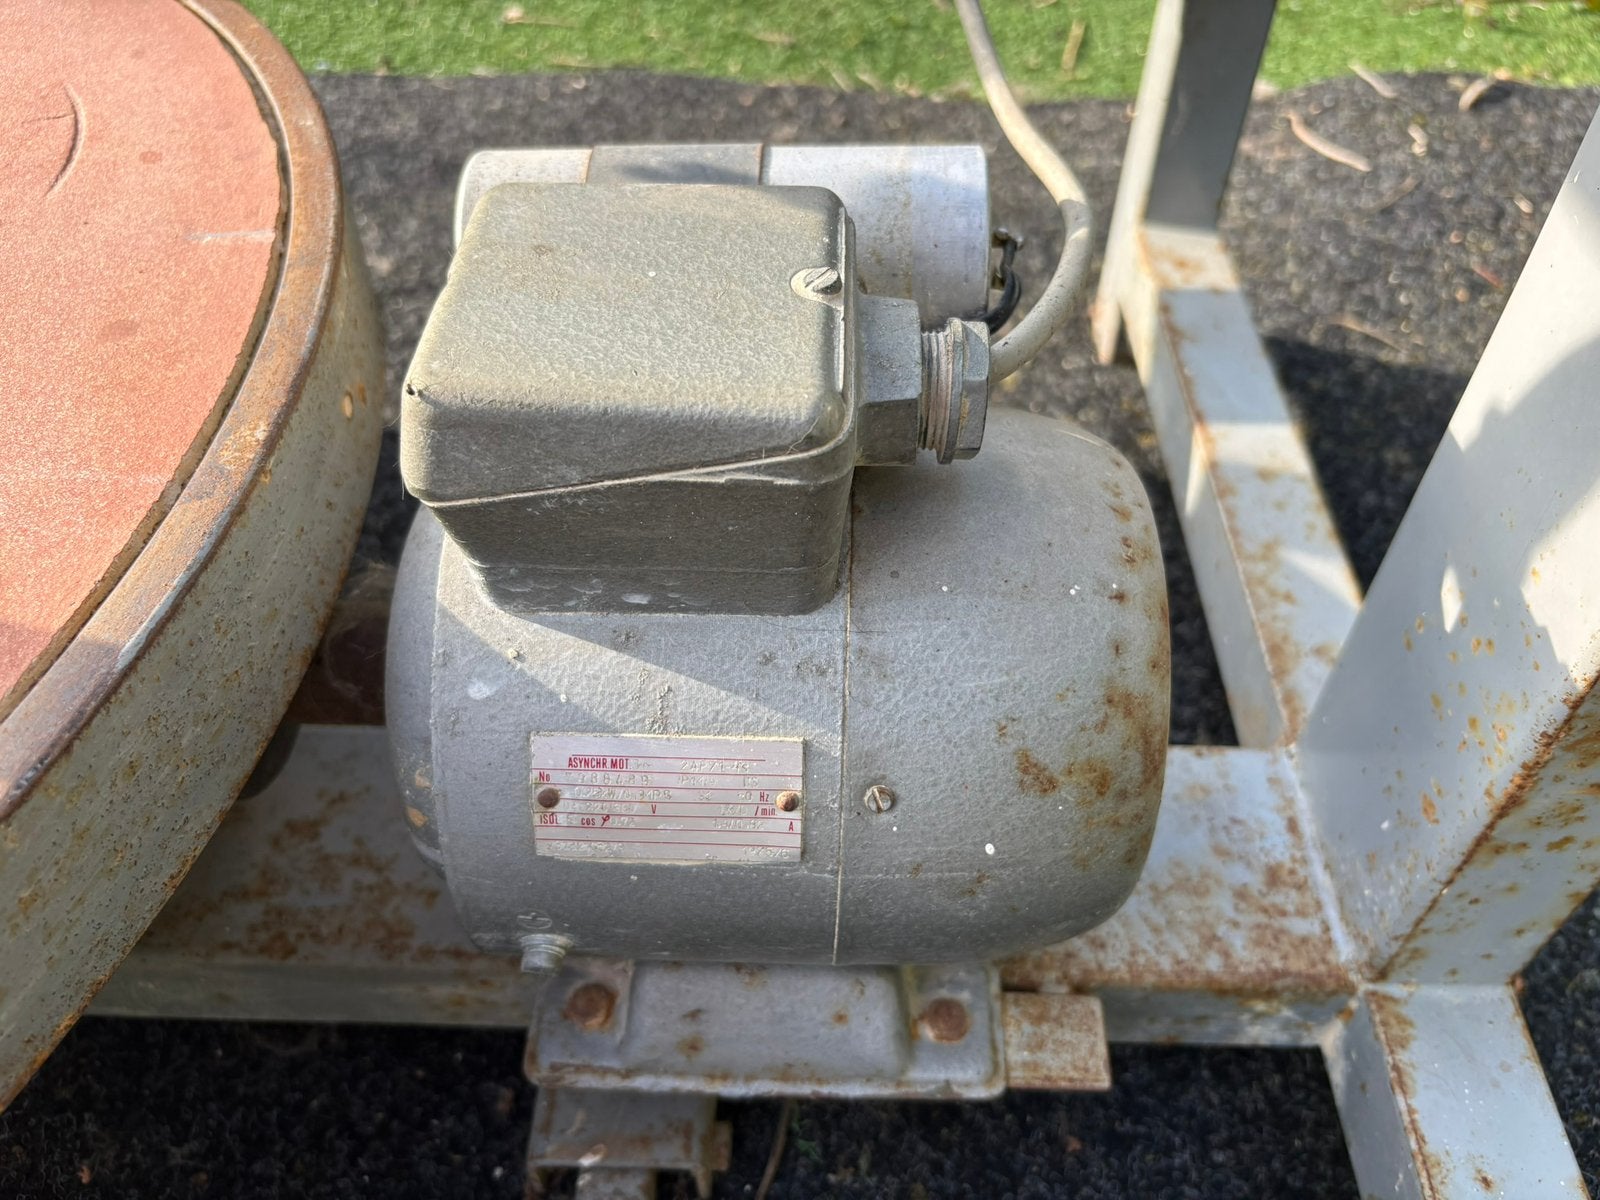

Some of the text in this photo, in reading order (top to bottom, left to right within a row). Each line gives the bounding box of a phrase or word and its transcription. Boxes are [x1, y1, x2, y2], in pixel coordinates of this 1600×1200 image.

[760, 791, 769, 802] Hz
[651, 804, 657, 814] V
[581, 817, 596, 826] cos
[789, 821, 794, 832] A
